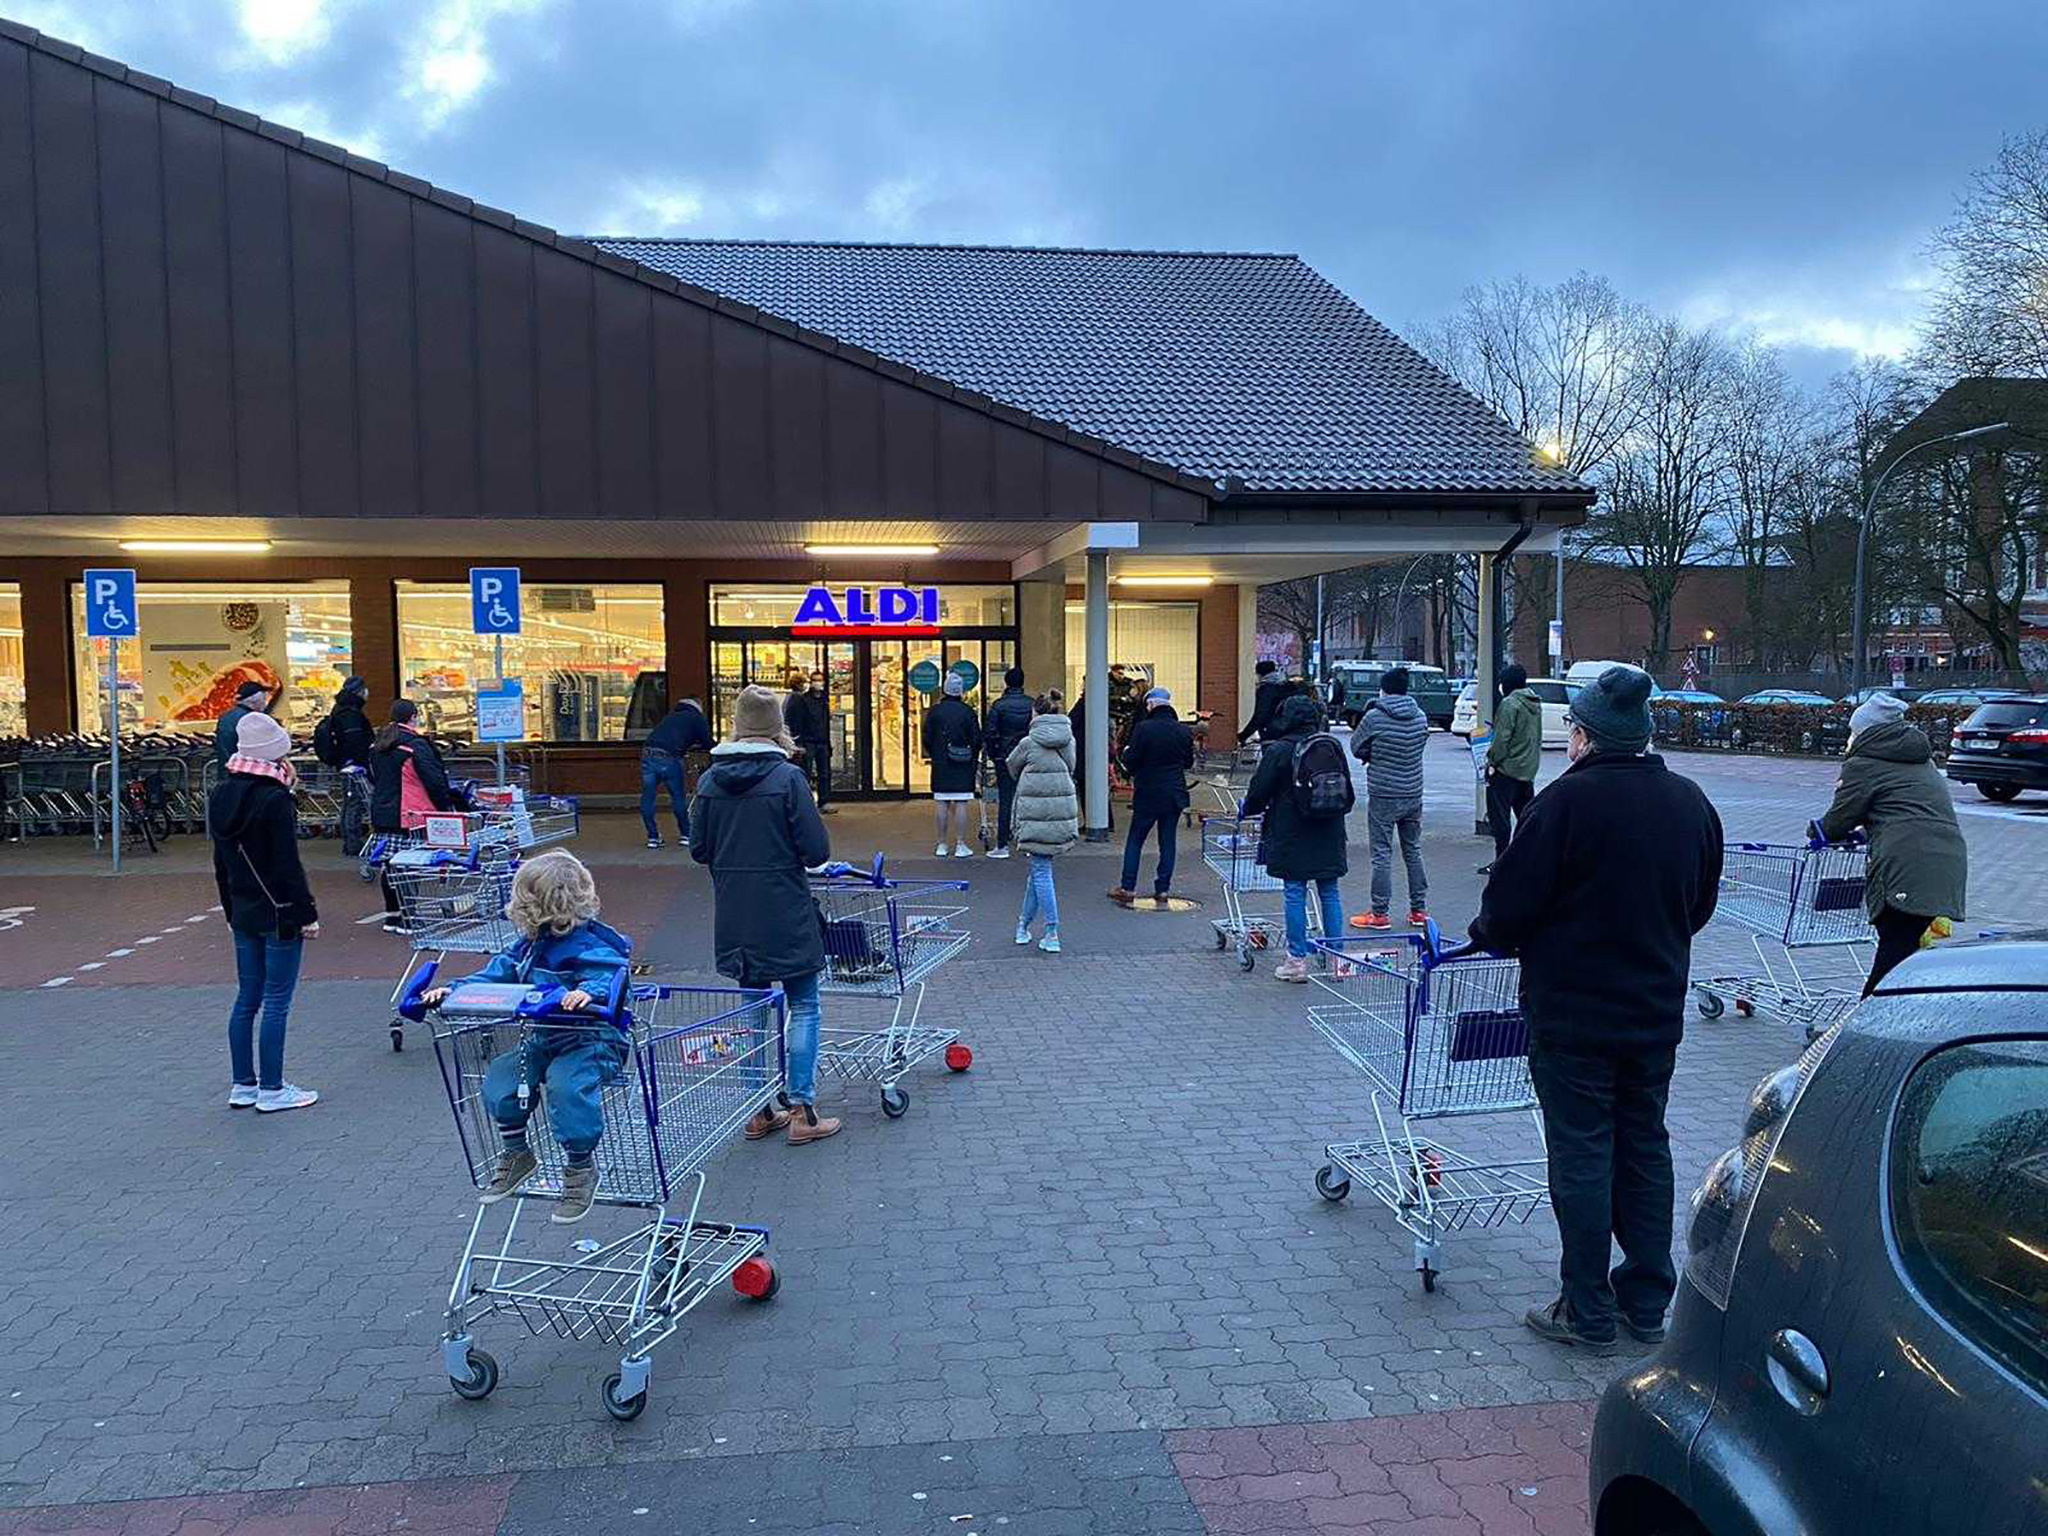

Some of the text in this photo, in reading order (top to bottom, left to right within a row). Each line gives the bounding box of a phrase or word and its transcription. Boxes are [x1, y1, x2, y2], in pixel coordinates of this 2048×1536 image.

[95, 579, 118, 605] P
[481, 578, 502, 603] P
[794, 587, 939, 624] ALDI
